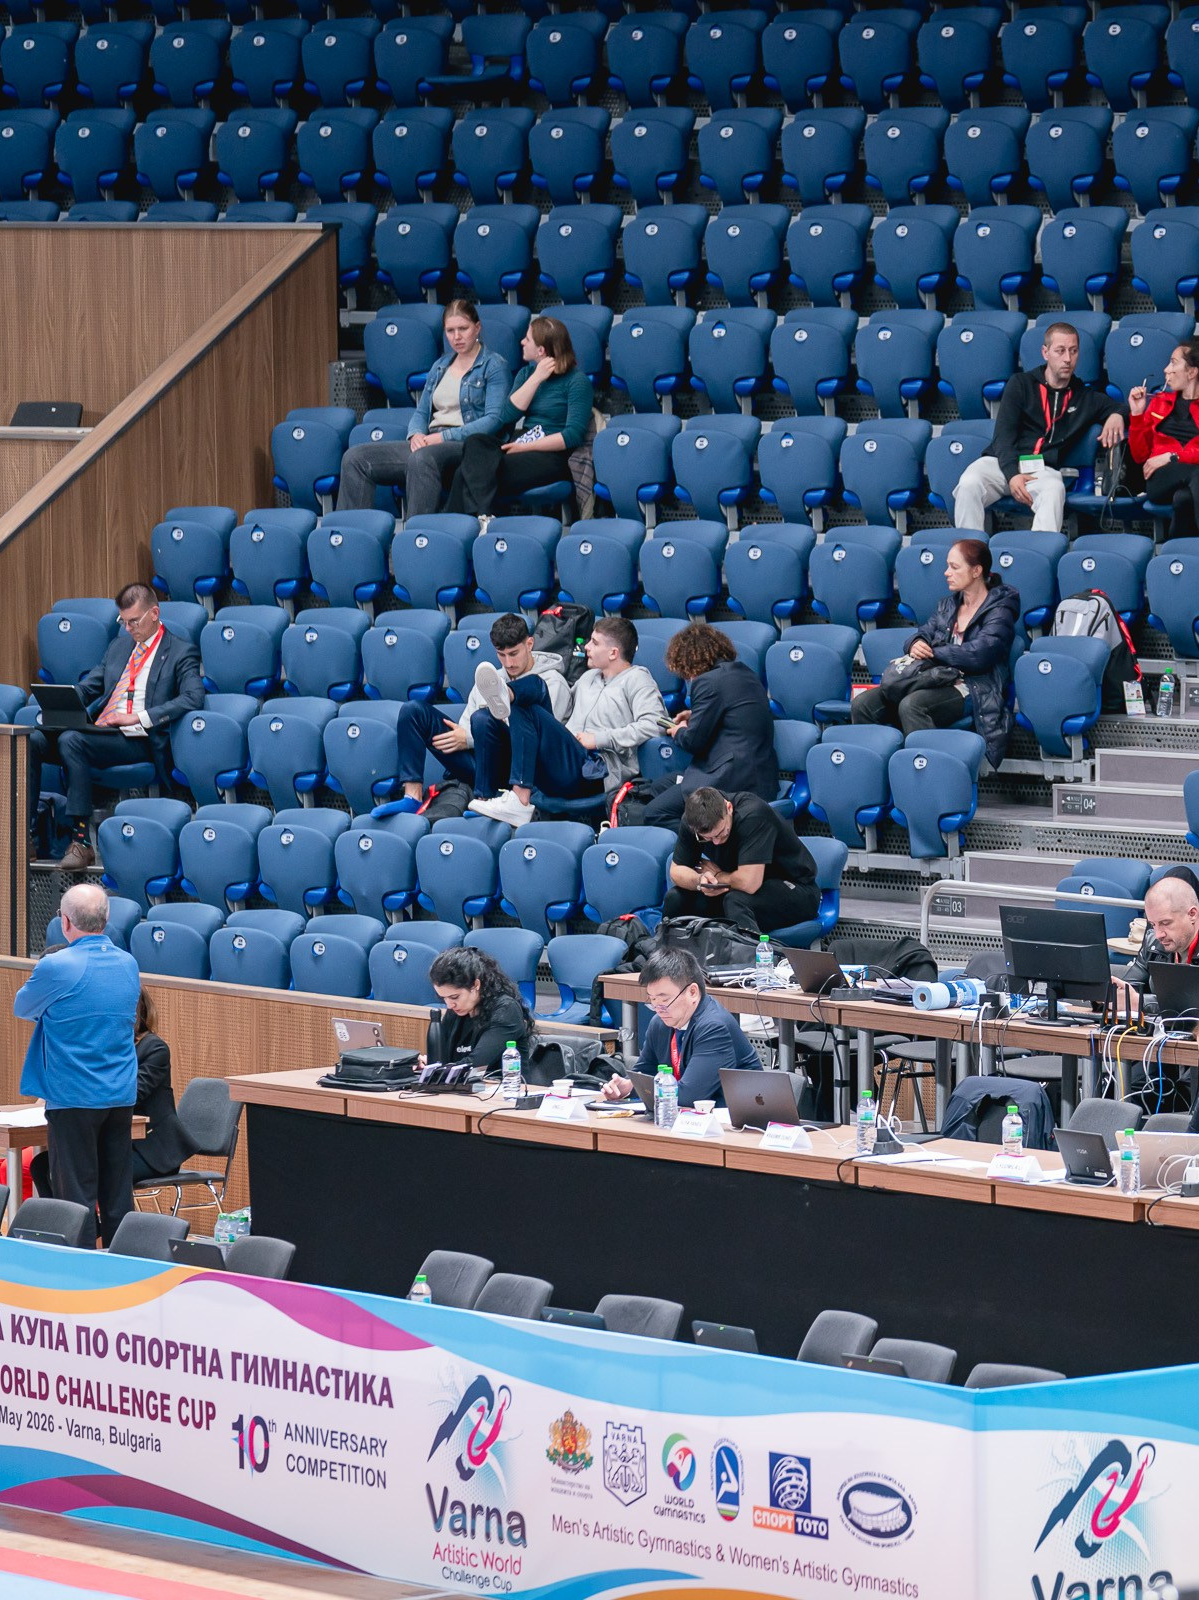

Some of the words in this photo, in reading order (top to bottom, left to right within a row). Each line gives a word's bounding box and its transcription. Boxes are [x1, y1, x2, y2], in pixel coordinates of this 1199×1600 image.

[1083, 798, 1093, 809] 04
[952, 901, 961, 912] 03
[1006, 914, 1027, 924] acer
[10, 1314, 69, 1353] КУПА
[76, 1325, 108, 1359] ПО
[116, 1332, 223, 1379] СПОРТНА
[231, 1351, 394, 1408] ГИМНАСТИКА
[0, 1365, 50, 1400] ORLD
[56, 1375, 171, 1423] CHALLENGE
[178, 1396, 216, 1430] CUP
[26, 1410, 55, 1432] 2026
[66, 1418, 105, 1446] Varna,
[110, 1426, 162, 1453] Bulgaria
[284, 1422, 387, 1458] ANNIVERSARY
[286, 1454, 386, 1490] COMPETITION
[426, 1483, 528, 1548] Varna
[664, 1494, 694, 1508] WORLD
[754, 1510, 793, 1530] СПОРТ
[796, 1518, 828, 1536] ТОТО
[432, 1542, 478, 1568] Artistic
[480, 1550, 522, 1576] World
[552, 1514, 589, 1537] Men's
[593, 1521, 634, 1545] Artistic
[638, 1530, 712, 1560] Gymnastics
[716, 1544, 725, 1562] &
[729, 1545, 789, 1574] Women's
[792, 1558, 838, 1584] Artistic
[842, 1567, 919, 1598] Gymnastics
[442, 1566, 490, 1589] Challenge
[493, 1575, 512, 1593] Cup
